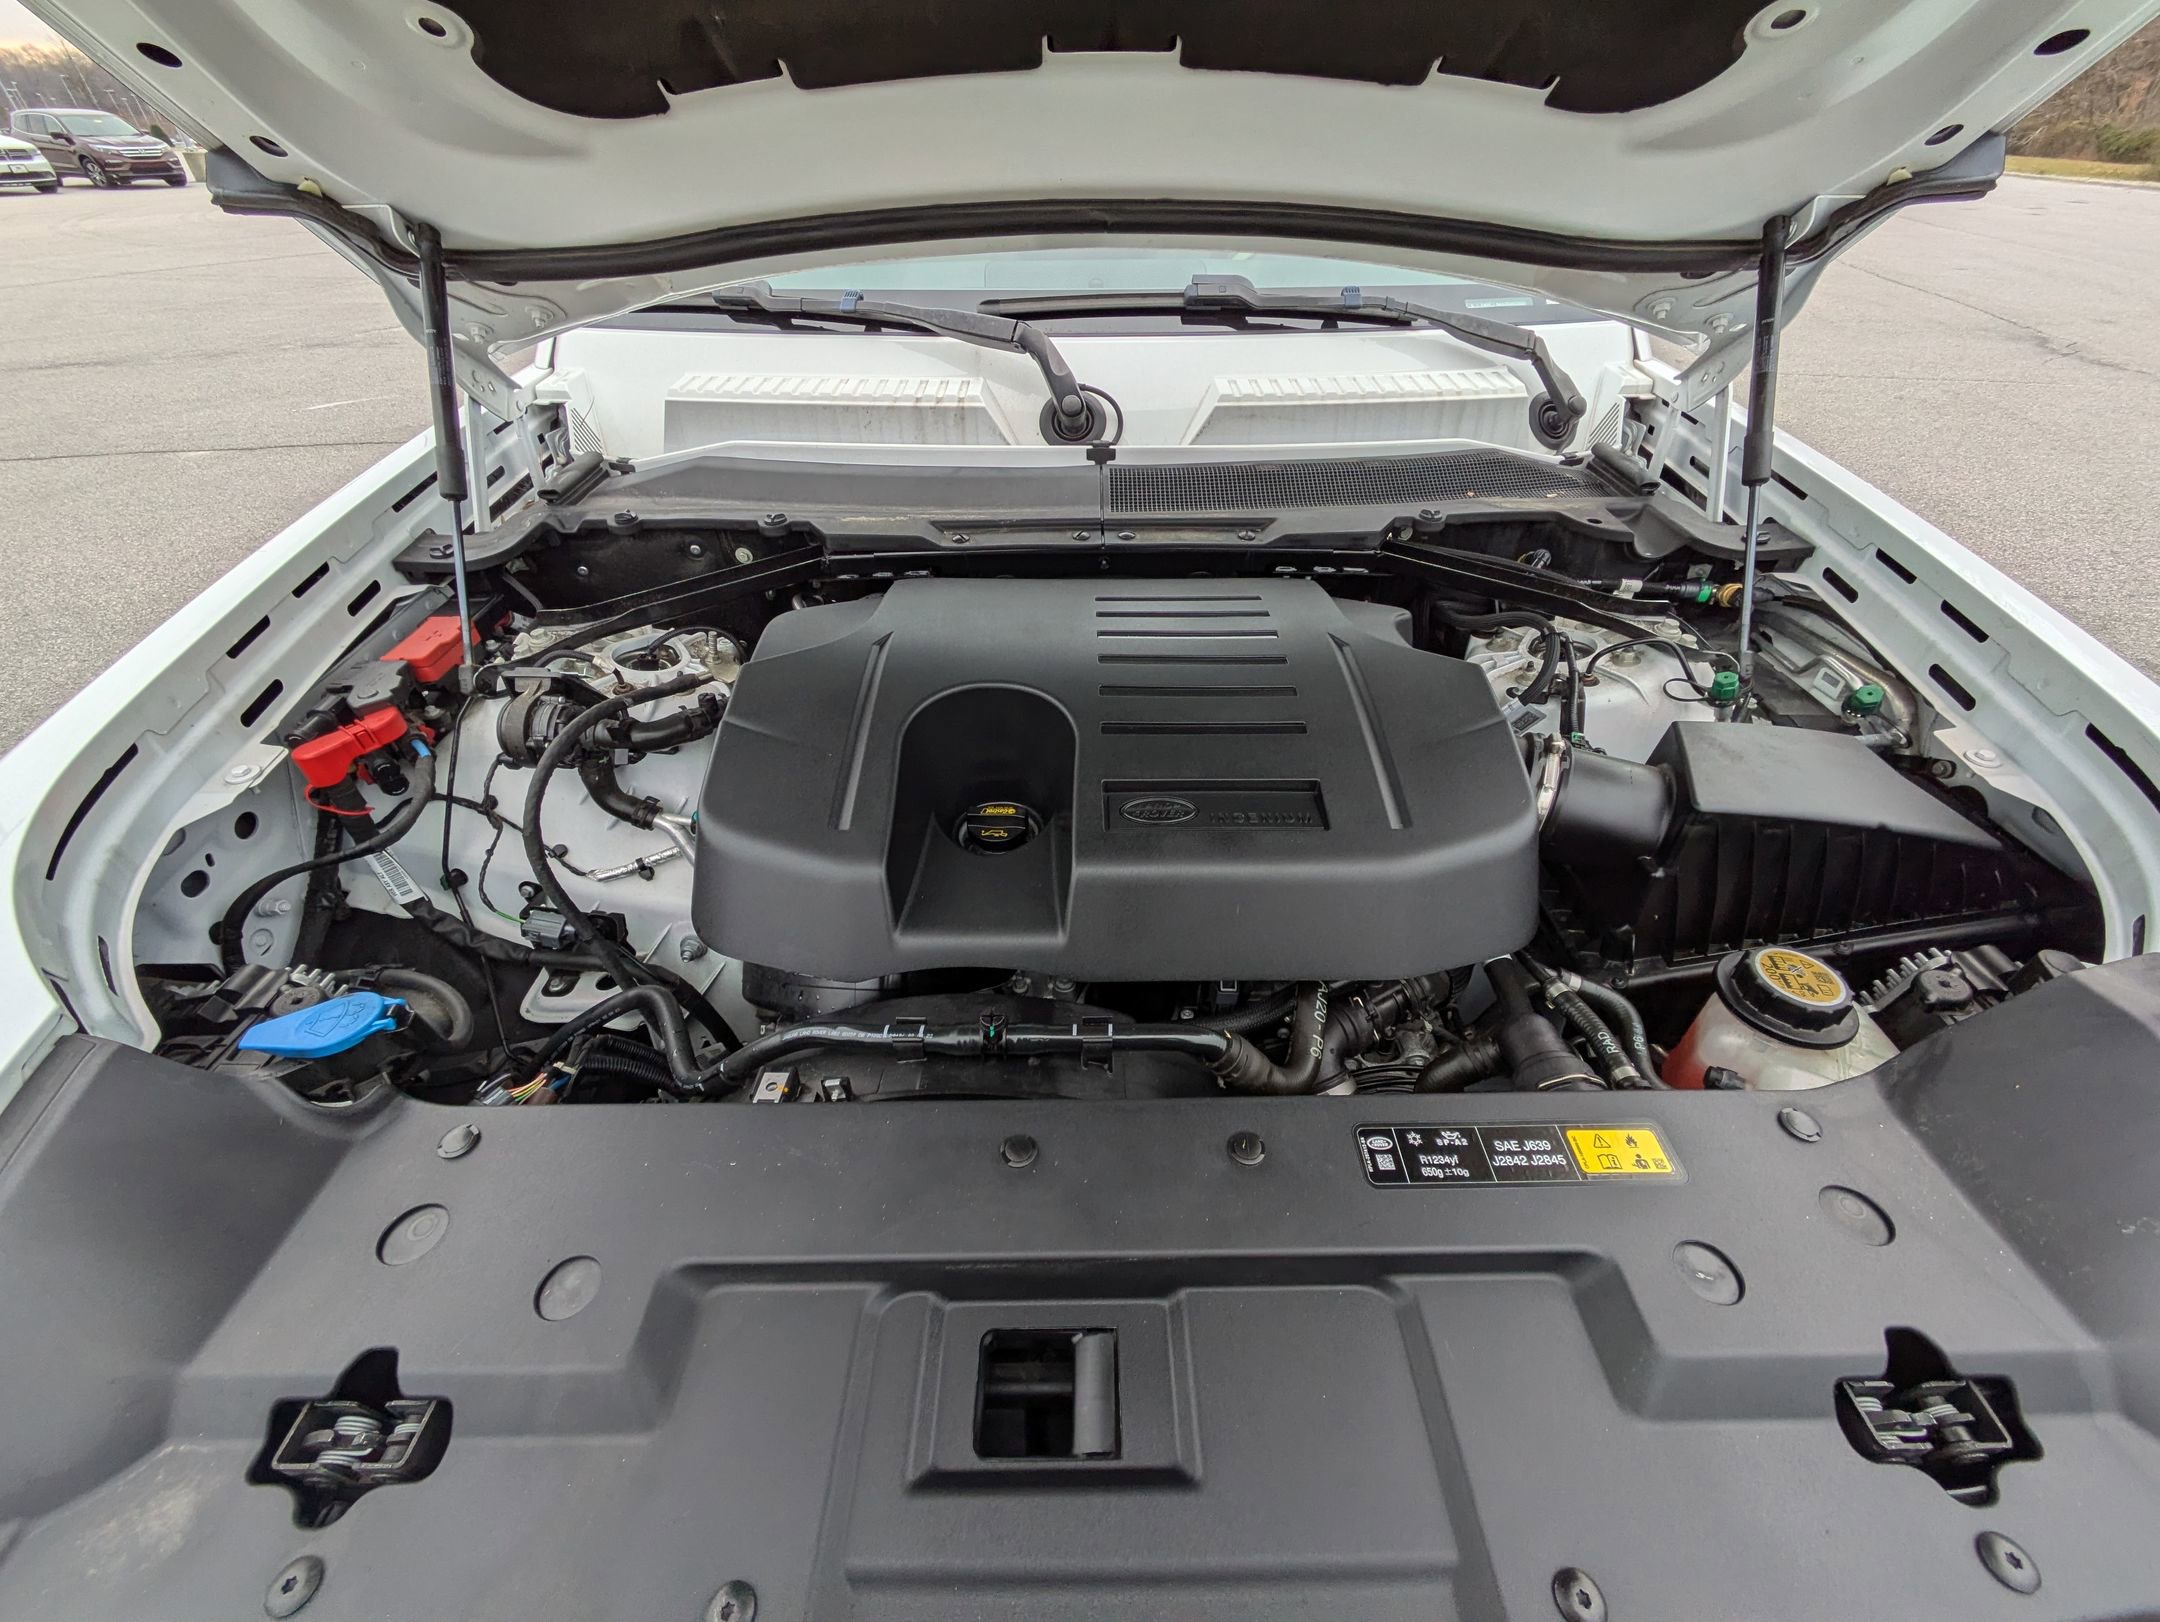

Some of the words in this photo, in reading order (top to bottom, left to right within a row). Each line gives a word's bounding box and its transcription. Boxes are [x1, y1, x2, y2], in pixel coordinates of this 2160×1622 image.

[1598, 1032, 1620, 1054] RAD
[1494, 1140, 1522, 1152] SAE
[1523, 1140, 1552, 1151] J639
[1420, 1154, 1459, 1166] R1234yf
[1492, 1155, 1529, 1166] J2842
[1530, 1154, 1567, 1165] J2845
[1421, 1167, 1444, 1179] 650g
